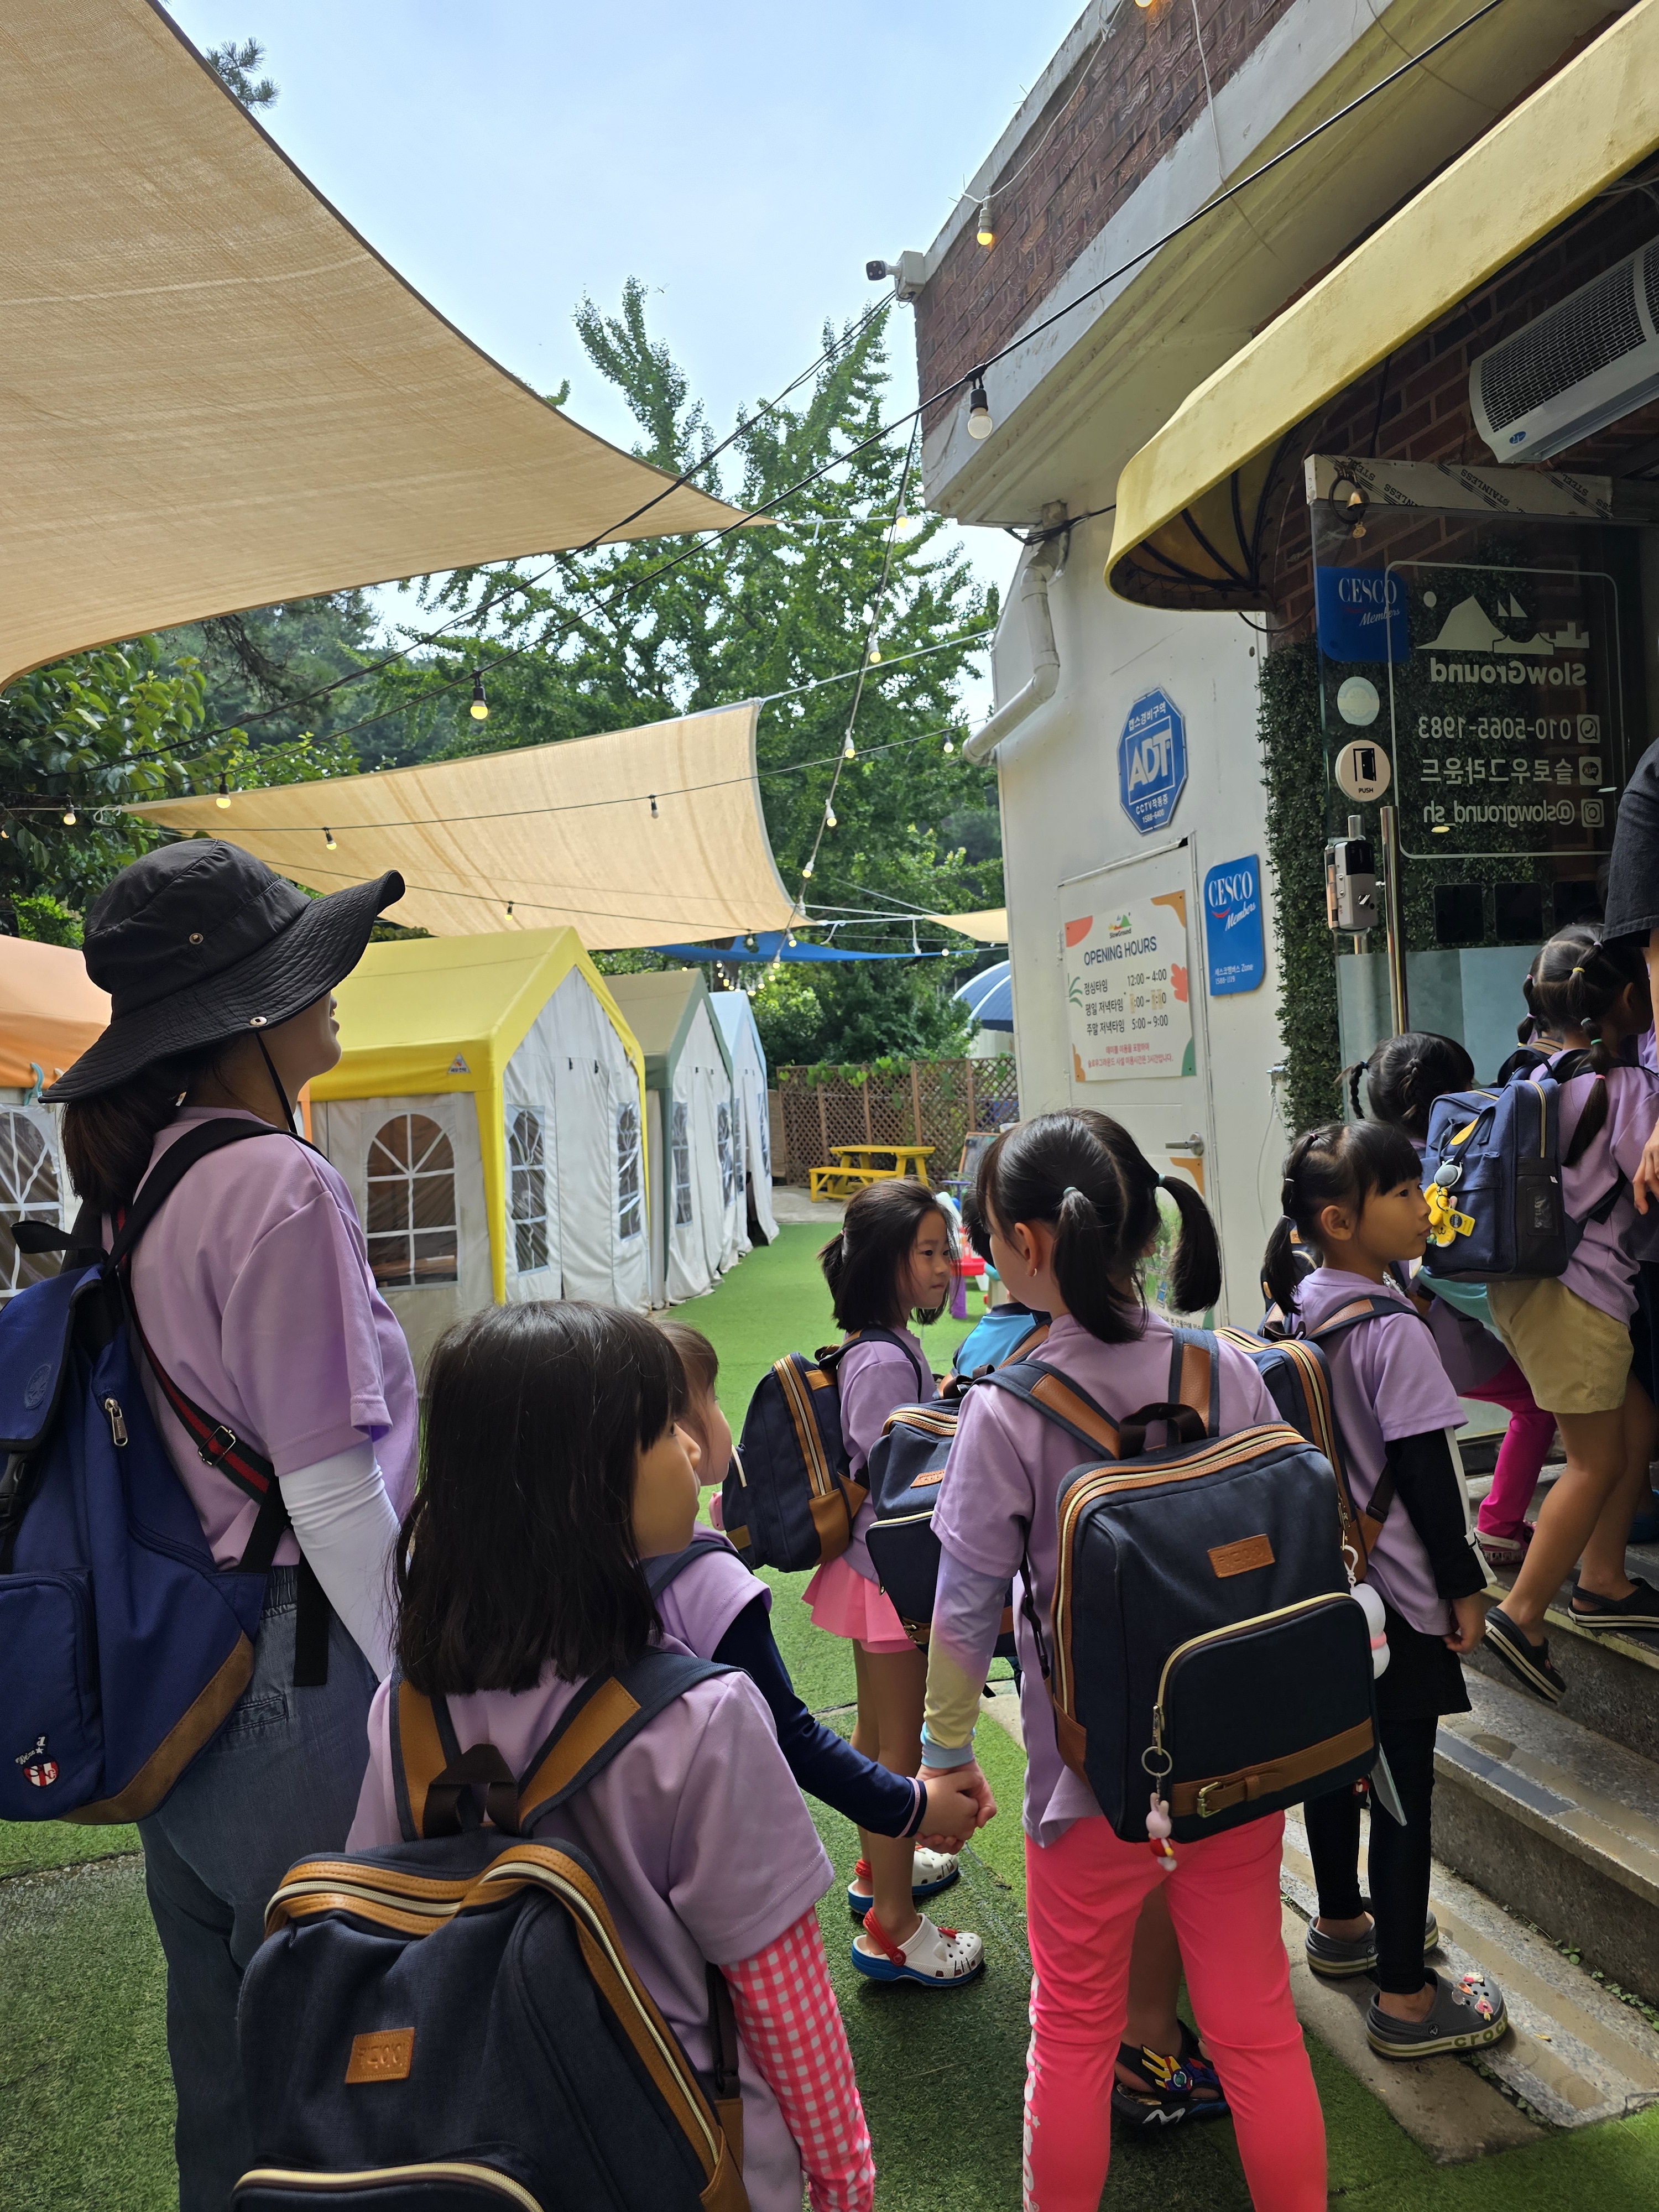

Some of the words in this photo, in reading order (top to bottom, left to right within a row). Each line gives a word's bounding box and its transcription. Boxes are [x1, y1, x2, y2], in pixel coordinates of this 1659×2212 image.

[1459, 468, 1510, 507] STAINLESS
[1338, 577, 1397, 604] CESCO
[1359, 606, 1400, 627] Members
[1128, 701, 1166, 732] 캡스경비구역
[1129, 728, 1171, 792] ADT
[1208, 870, 1253, 907] CESCO
[1224, 901, 1256, 931] Members
[1109, 927, 1132, 939] SlowGround
[1084, 944, 1123, 966] OPENING
[1124, 936, 1157, 957] HOURS
[1127, 973, 1144, 987] 12:00
[1152, 968, 1167, 982] 4:00
[1241, 963, 1254, 972] Zone
[1085, 1002, 1097, 1016] 평일
[1099, 998, 1123, 1013] 저녁타임
[1130, 995, 1144, 1009] :00
[1152, 992, 1167, 1005] :0
[1087, 1022, 1098, 1036] 주말
[1100, 1019, 1125, 1035] 저녁타임
[1132, 1018, 1146, 1030] 5:00
[1153, 1014, 1168, 1027] 9:00
